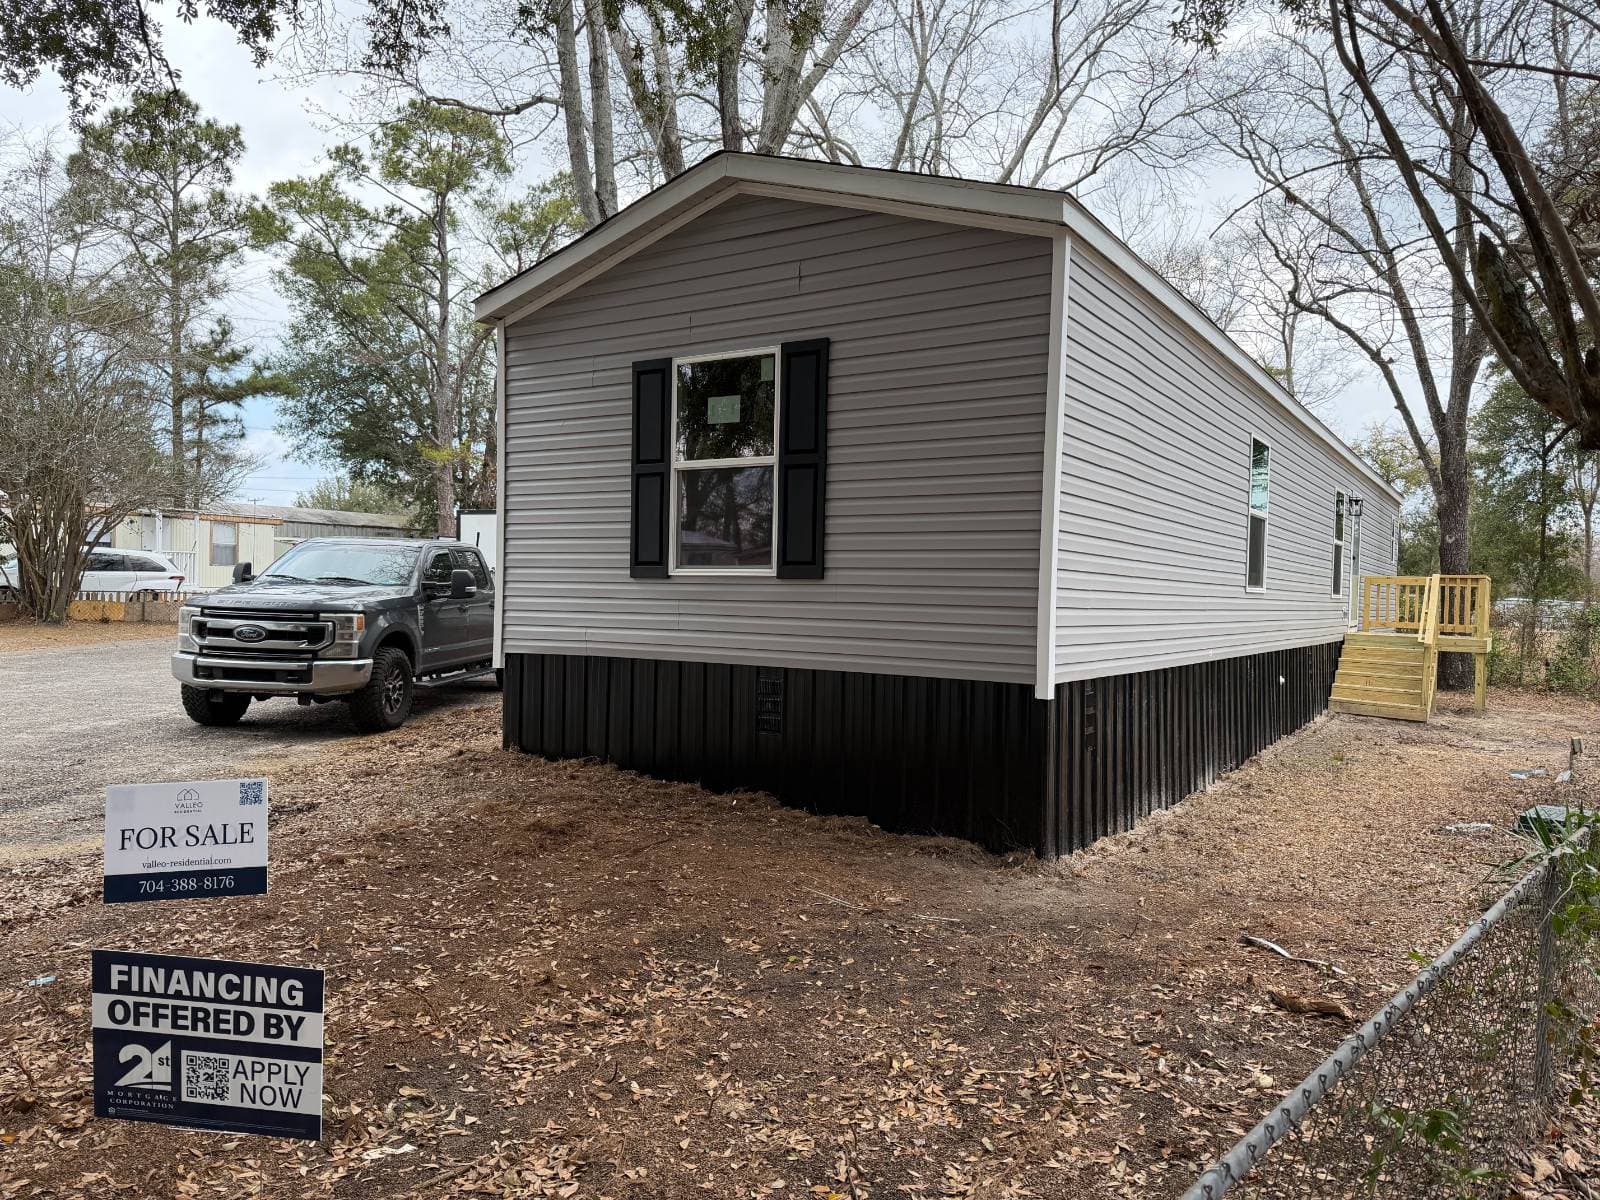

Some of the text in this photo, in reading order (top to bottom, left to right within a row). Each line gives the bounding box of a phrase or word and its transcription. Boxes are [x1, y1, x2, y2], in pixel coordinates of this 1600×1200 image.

[240, 628, 257, 638] Ford
[174, 801, 203, 809] VALLEO
[119, 822, 255, 851] FOR SALE
[142, 856, 232, 869] valleo-residential.com
[138, 875, 235, 893] 704-388-8176
[110, 963, 304, 1007] FINANCING
[107, 999, 306, 1041] OFFERED BY
[232, 1059, 310, 1087] APPLY
[107, 1090, 178, 1102] MORTGAGE
[109, 1098, 175, 1110] CORPORATION
[240, 1082, 303, 1109] NOW
